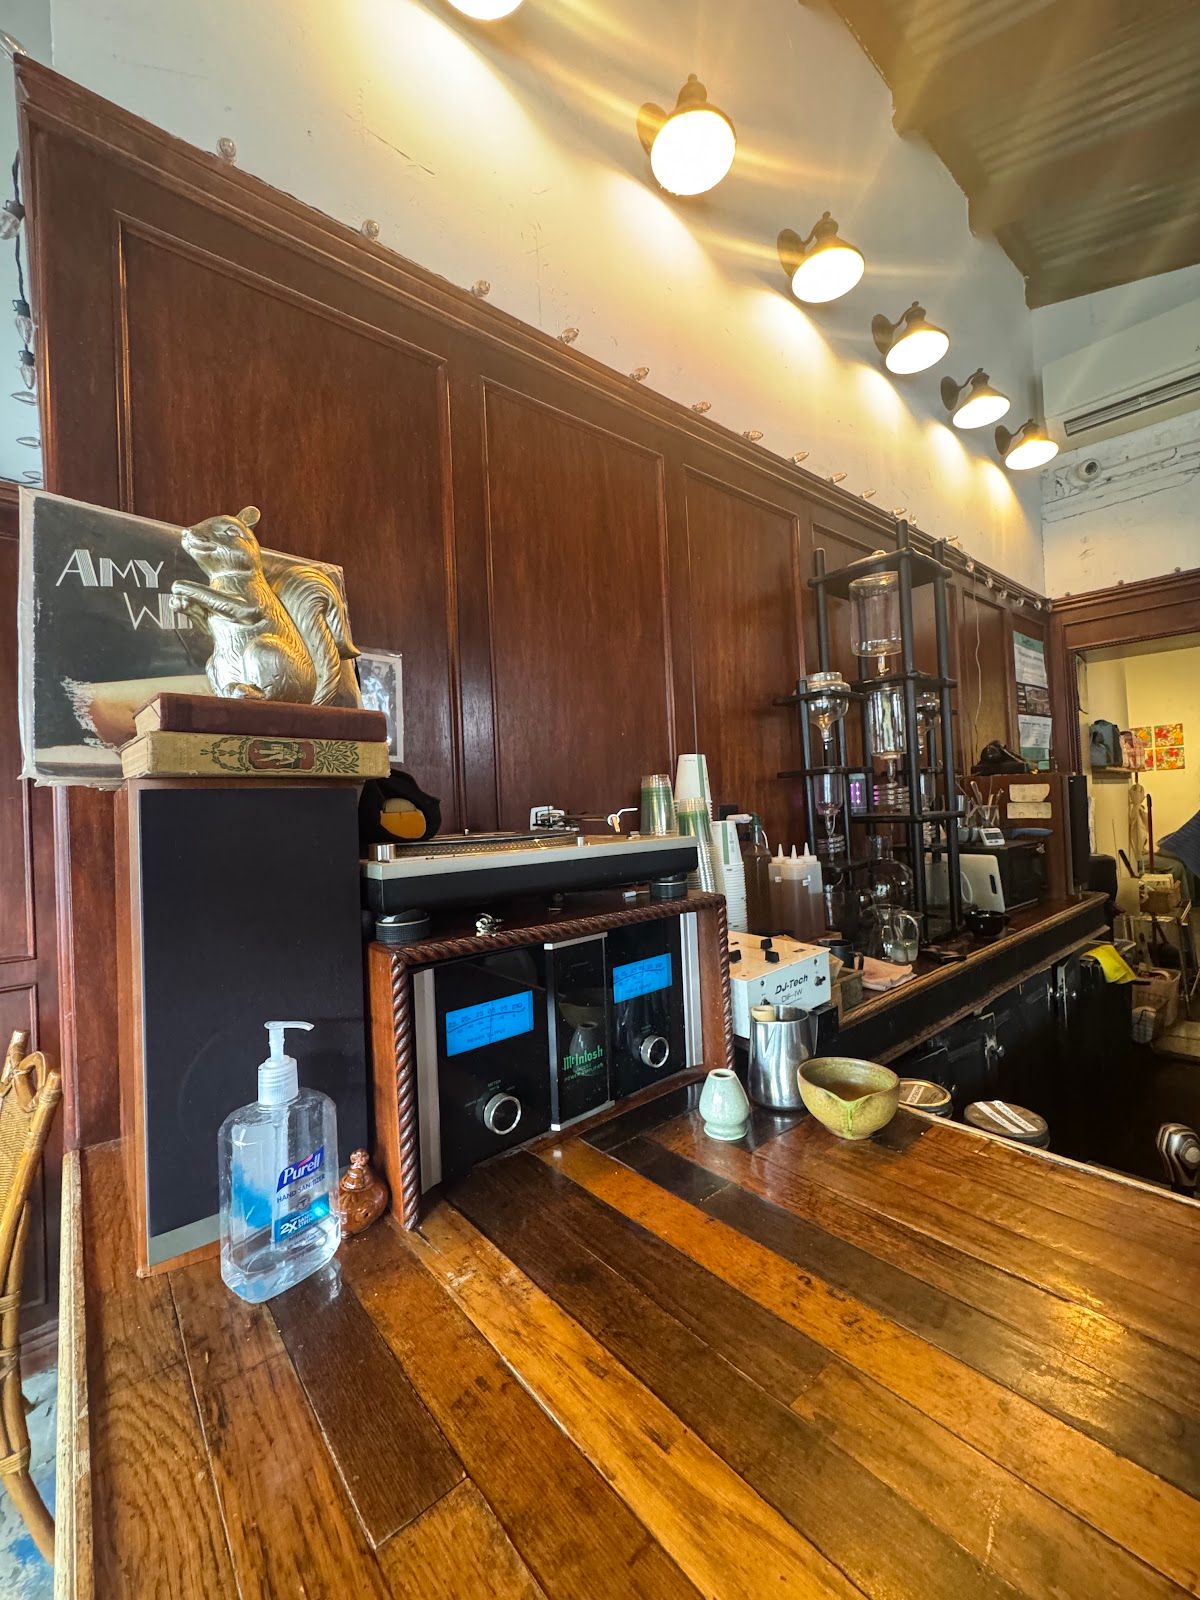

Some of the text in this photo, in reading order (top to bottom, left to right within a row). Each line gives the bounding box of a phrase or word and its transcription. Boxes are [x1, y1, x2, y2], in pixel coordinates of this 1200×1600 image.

[56, 548, 164, 588] AMY
[775, 974, 808, 995] DJ-Tech
[563, 1044, 603, 1071] McIntosh
[283, 1152, 321, 1185] Purell
[276, 1190, 297, 1204] HAND
[280, 1222, 298, 1236] 2X
